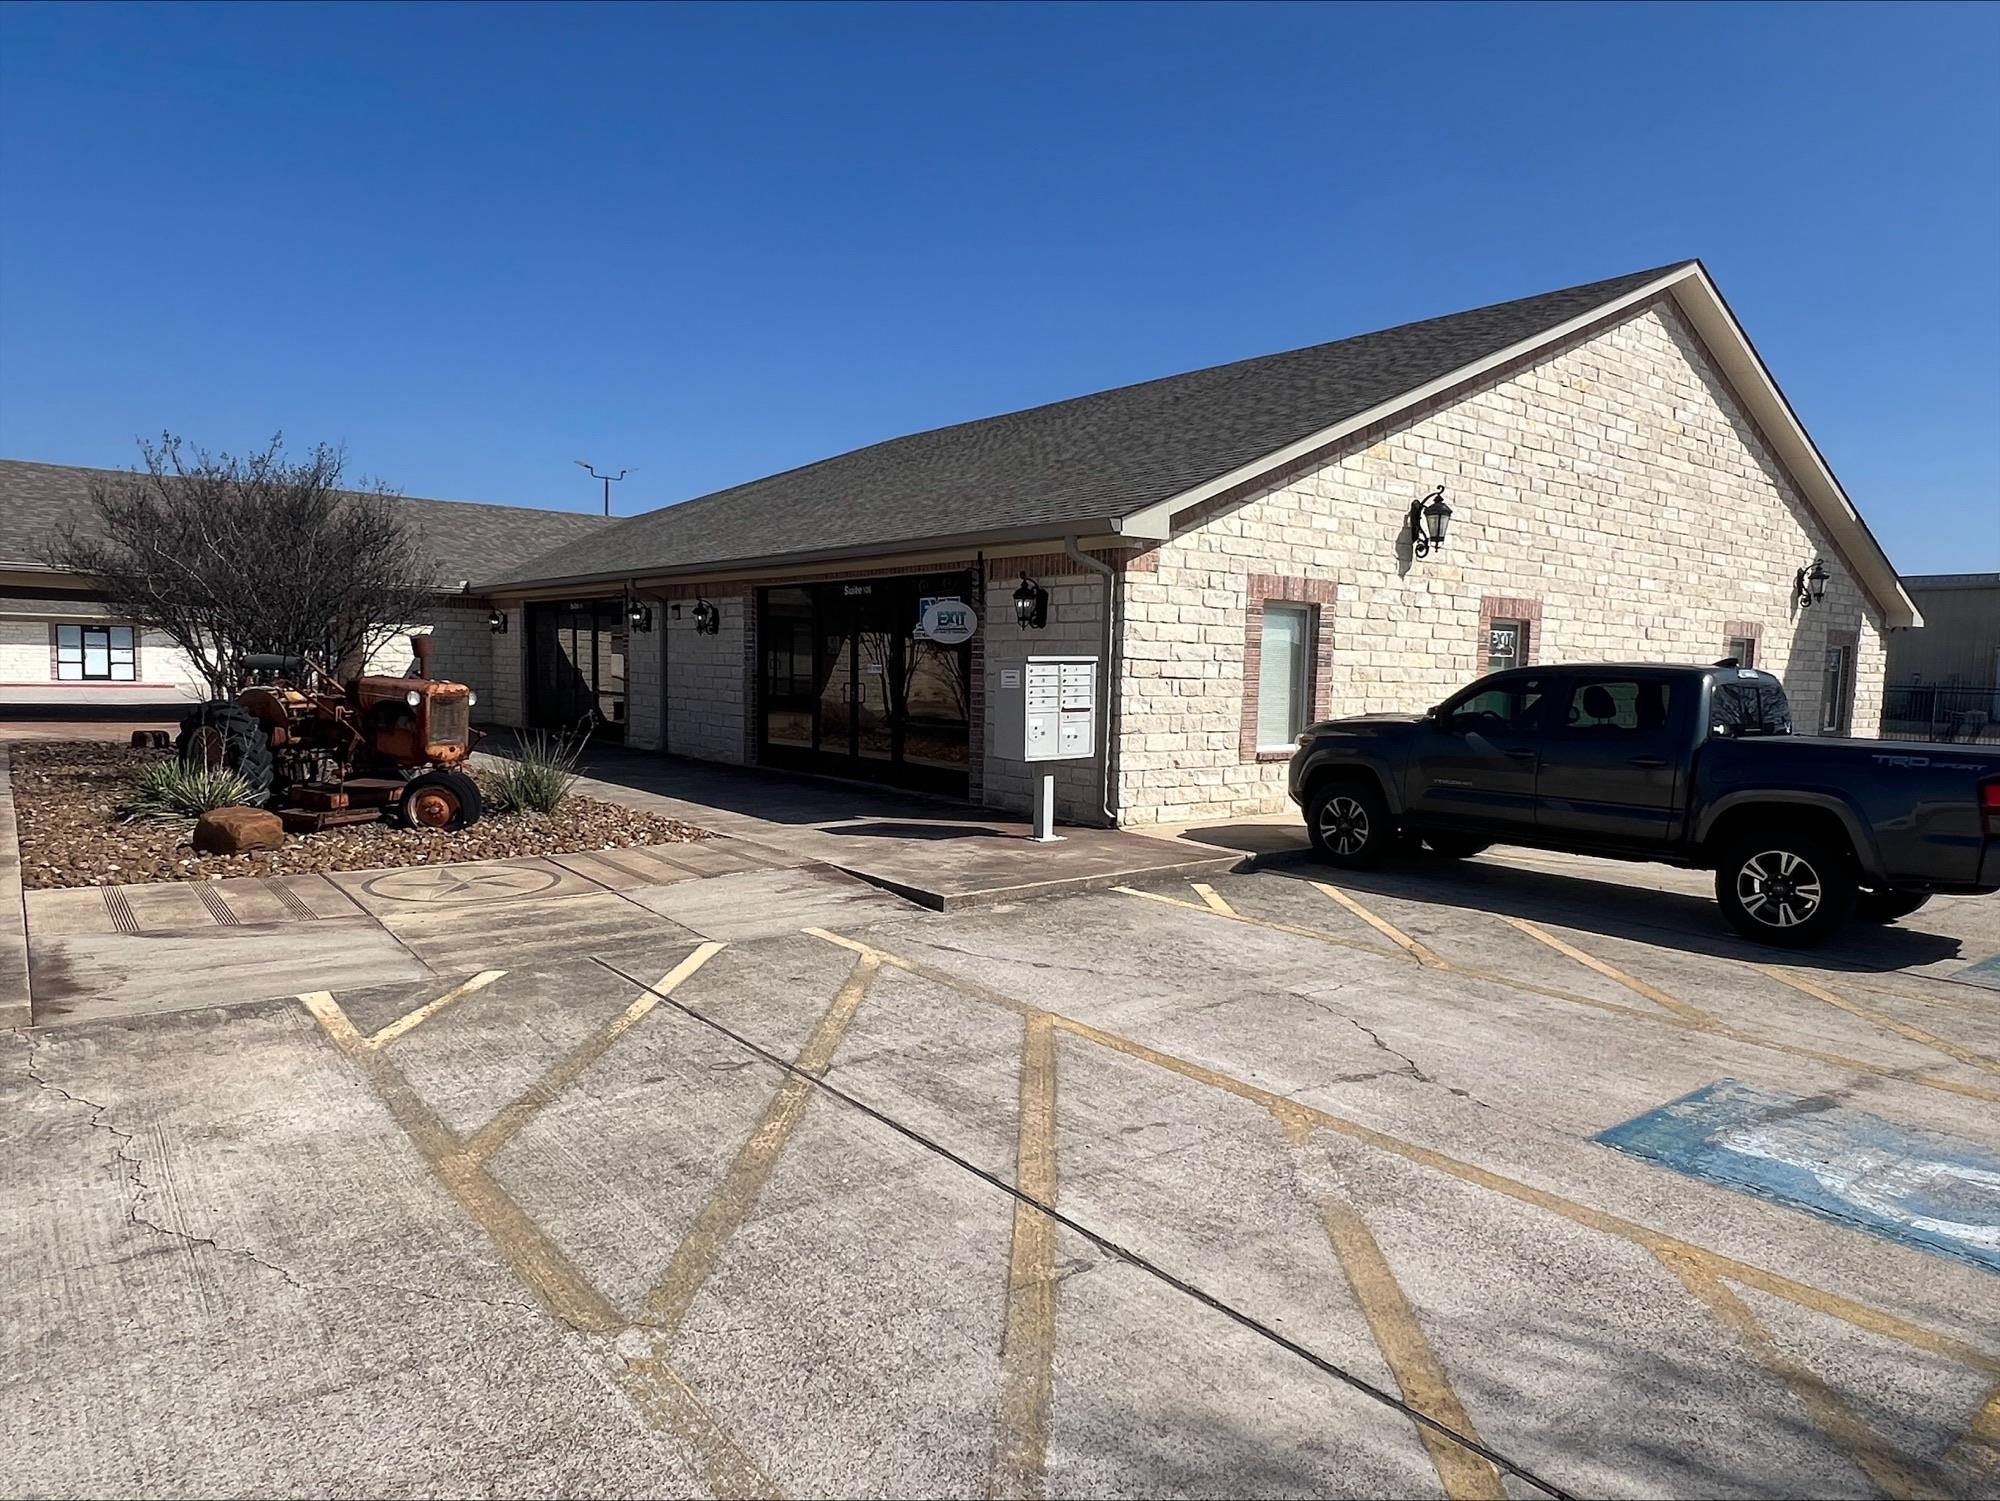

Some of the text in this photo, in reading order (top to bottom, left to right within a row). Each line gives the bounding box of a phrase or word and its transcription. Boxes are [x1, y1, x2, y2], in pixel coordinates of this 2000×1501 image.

[937, 611, 966, 626] EXIT
[1490, 631, 1512, 648] EXIT
[1871, 754, 1930, 769] TRD
